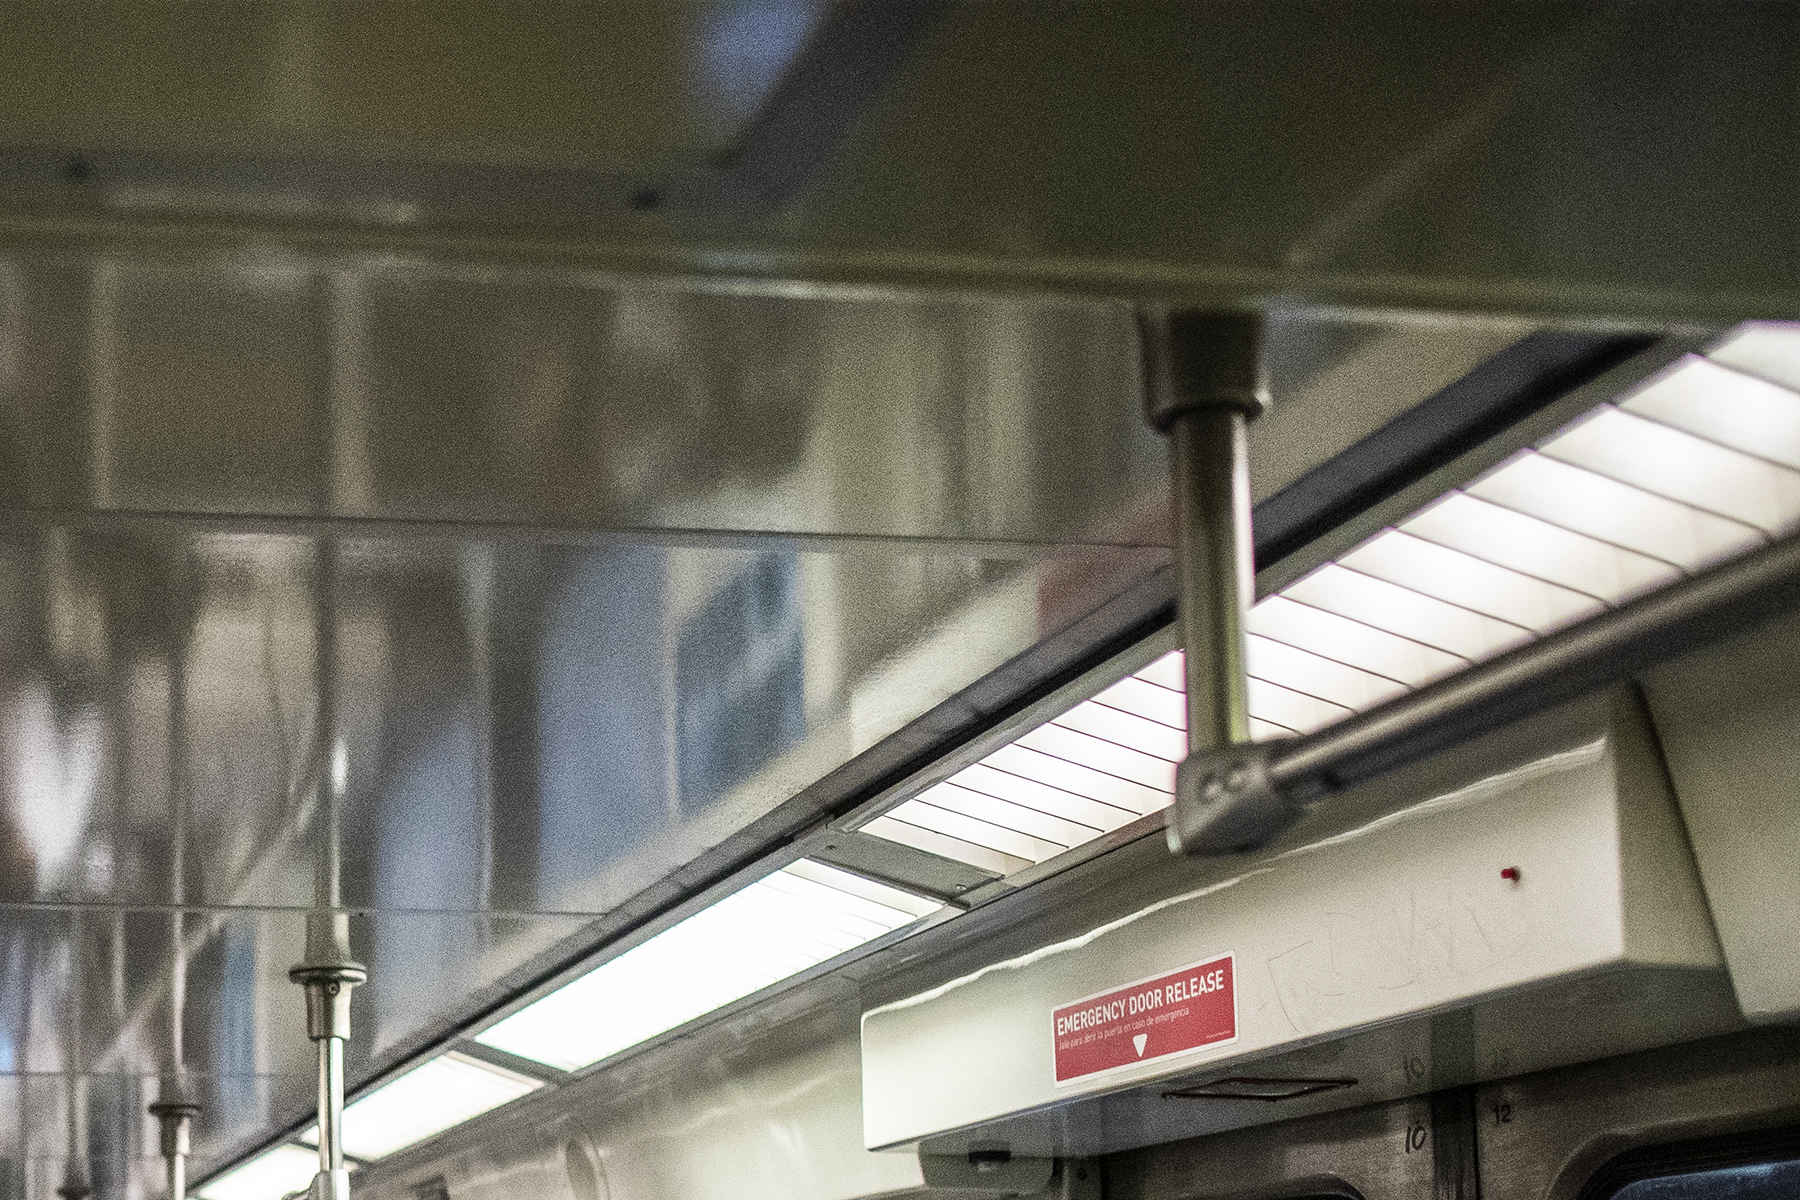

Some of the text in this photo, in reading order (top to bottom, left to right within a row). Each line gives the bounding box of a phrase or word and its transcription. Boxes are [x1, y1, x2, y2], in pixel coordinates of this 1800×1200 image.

[1057, 969, 1225, 1036] EMERGENCY DOOR RELEASE
[1105, 1026, 1122, 1040] puerta
[1132, 1020, 1145, 1030] caso
[1146, 1016, 1154, 1026] de
[1155, 1006, 1190, 1023] emergencia
[1492, 1102, 1512, 1127] 12
[1405, 1124, 1428, 1153] 10
